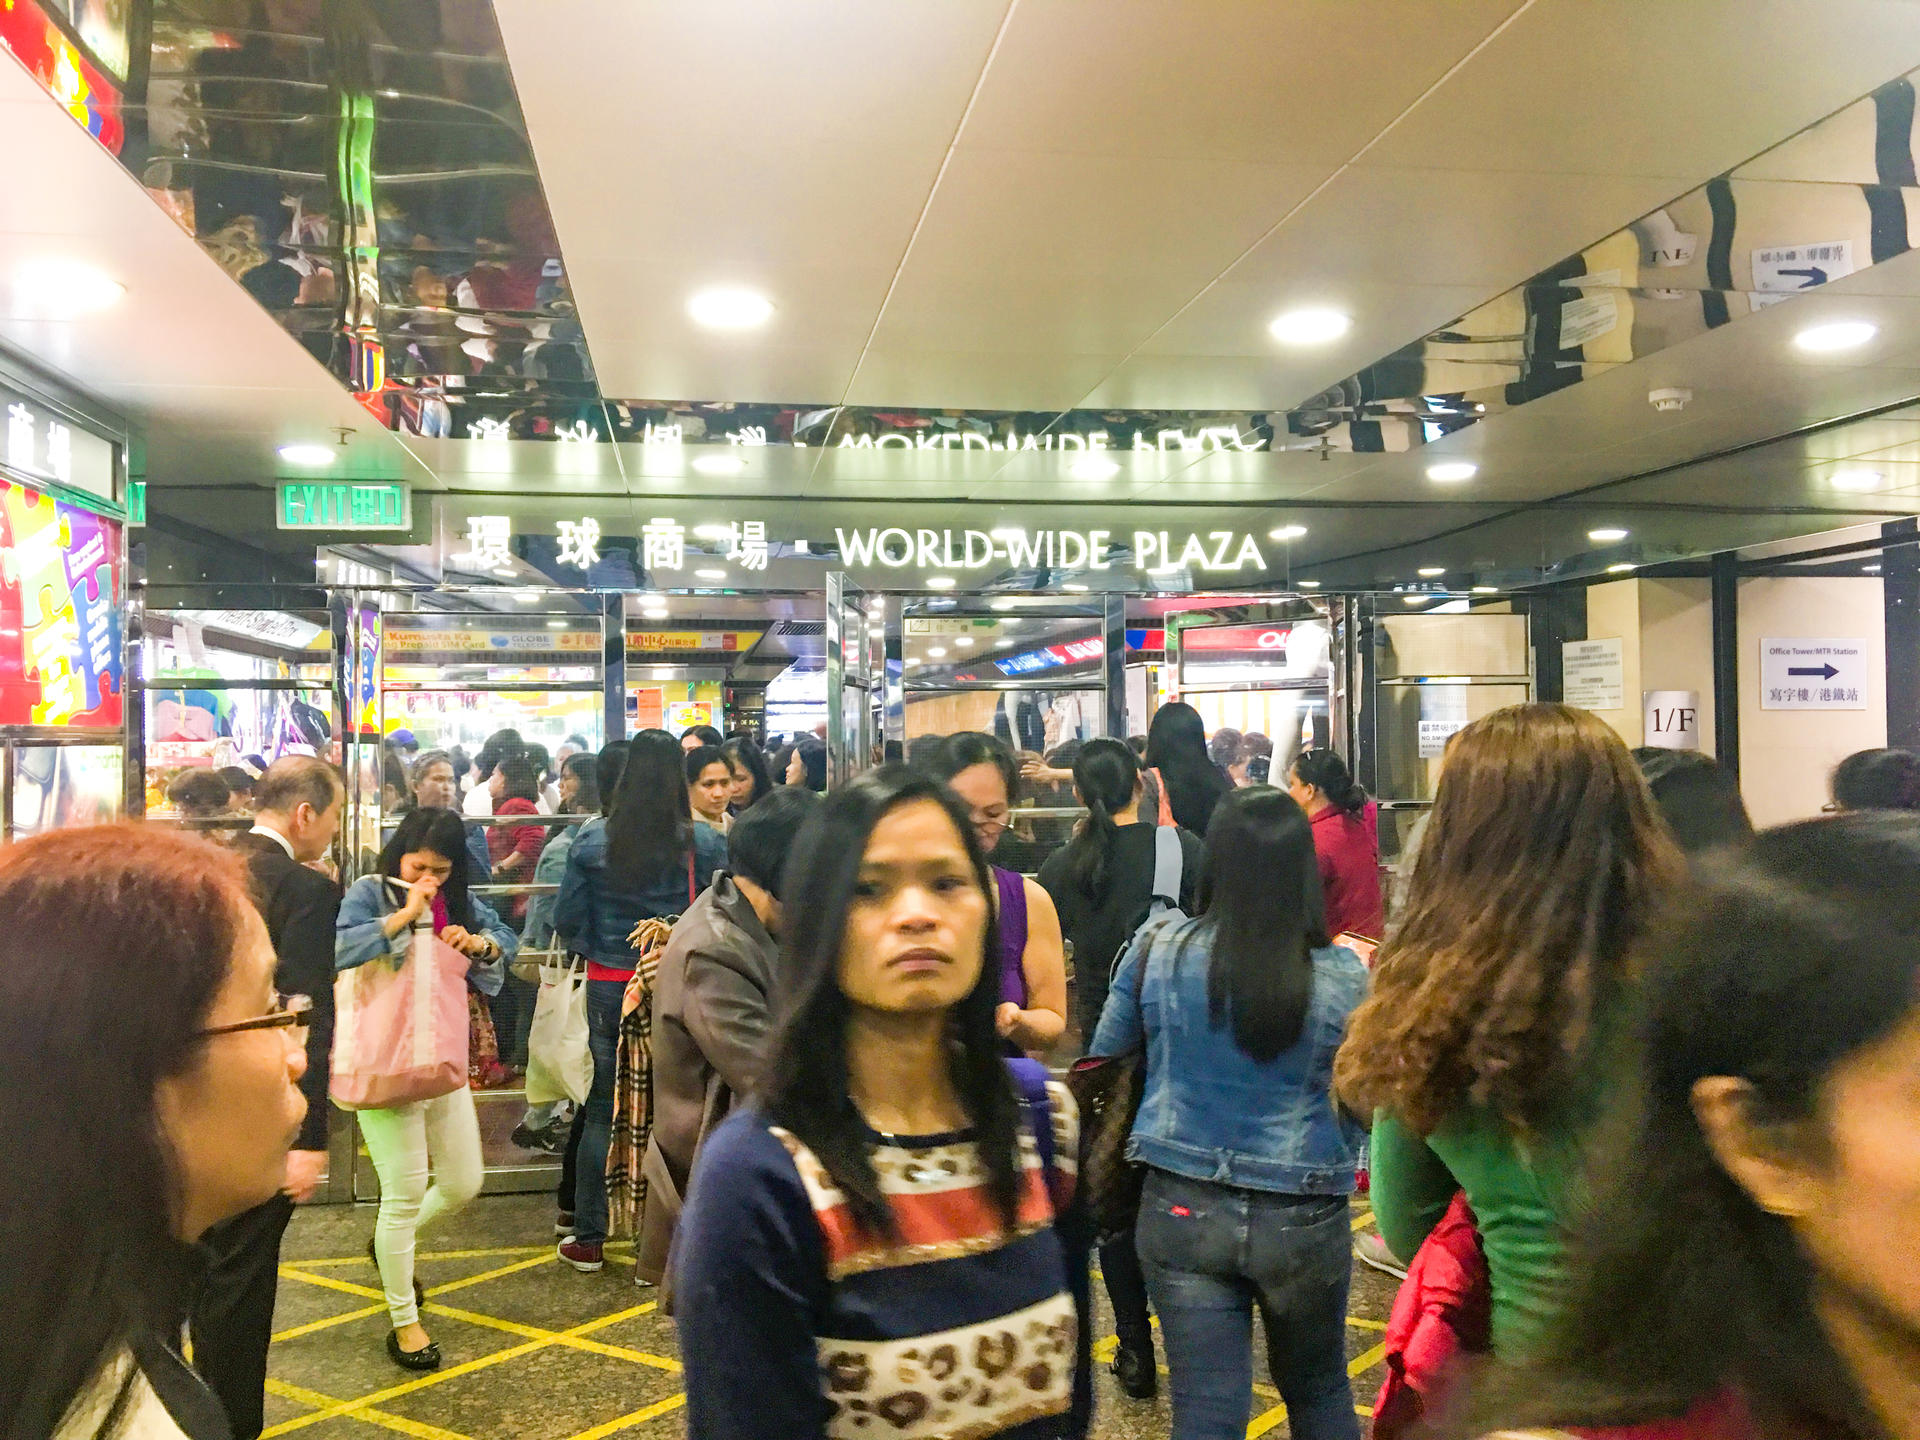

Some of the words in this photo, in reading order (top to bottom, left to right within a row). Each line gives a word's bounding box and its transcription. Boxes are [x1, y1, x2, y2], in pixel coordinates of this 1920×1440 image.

[285, 485, 346, 524] EXIT
[352, 485, 402, 524] 出口
[467, 515, 768, 570] 環球商場
[835, 527, 1110, 568] WORLD-WIDE
[1134, 531, 1267, 569] PLAZA
[400, 641, 439, 650] Prepaid
[462, 641, 485, 649] Card
[511, 635, 550, 643] GLOBE
[1769, 648, 1790, 656] Office
[1792, 648, 1831, 656] Tower/MTR
[1833, 648, 1858, 656] Station
[1652, 708, 1696, 732] 1/F
